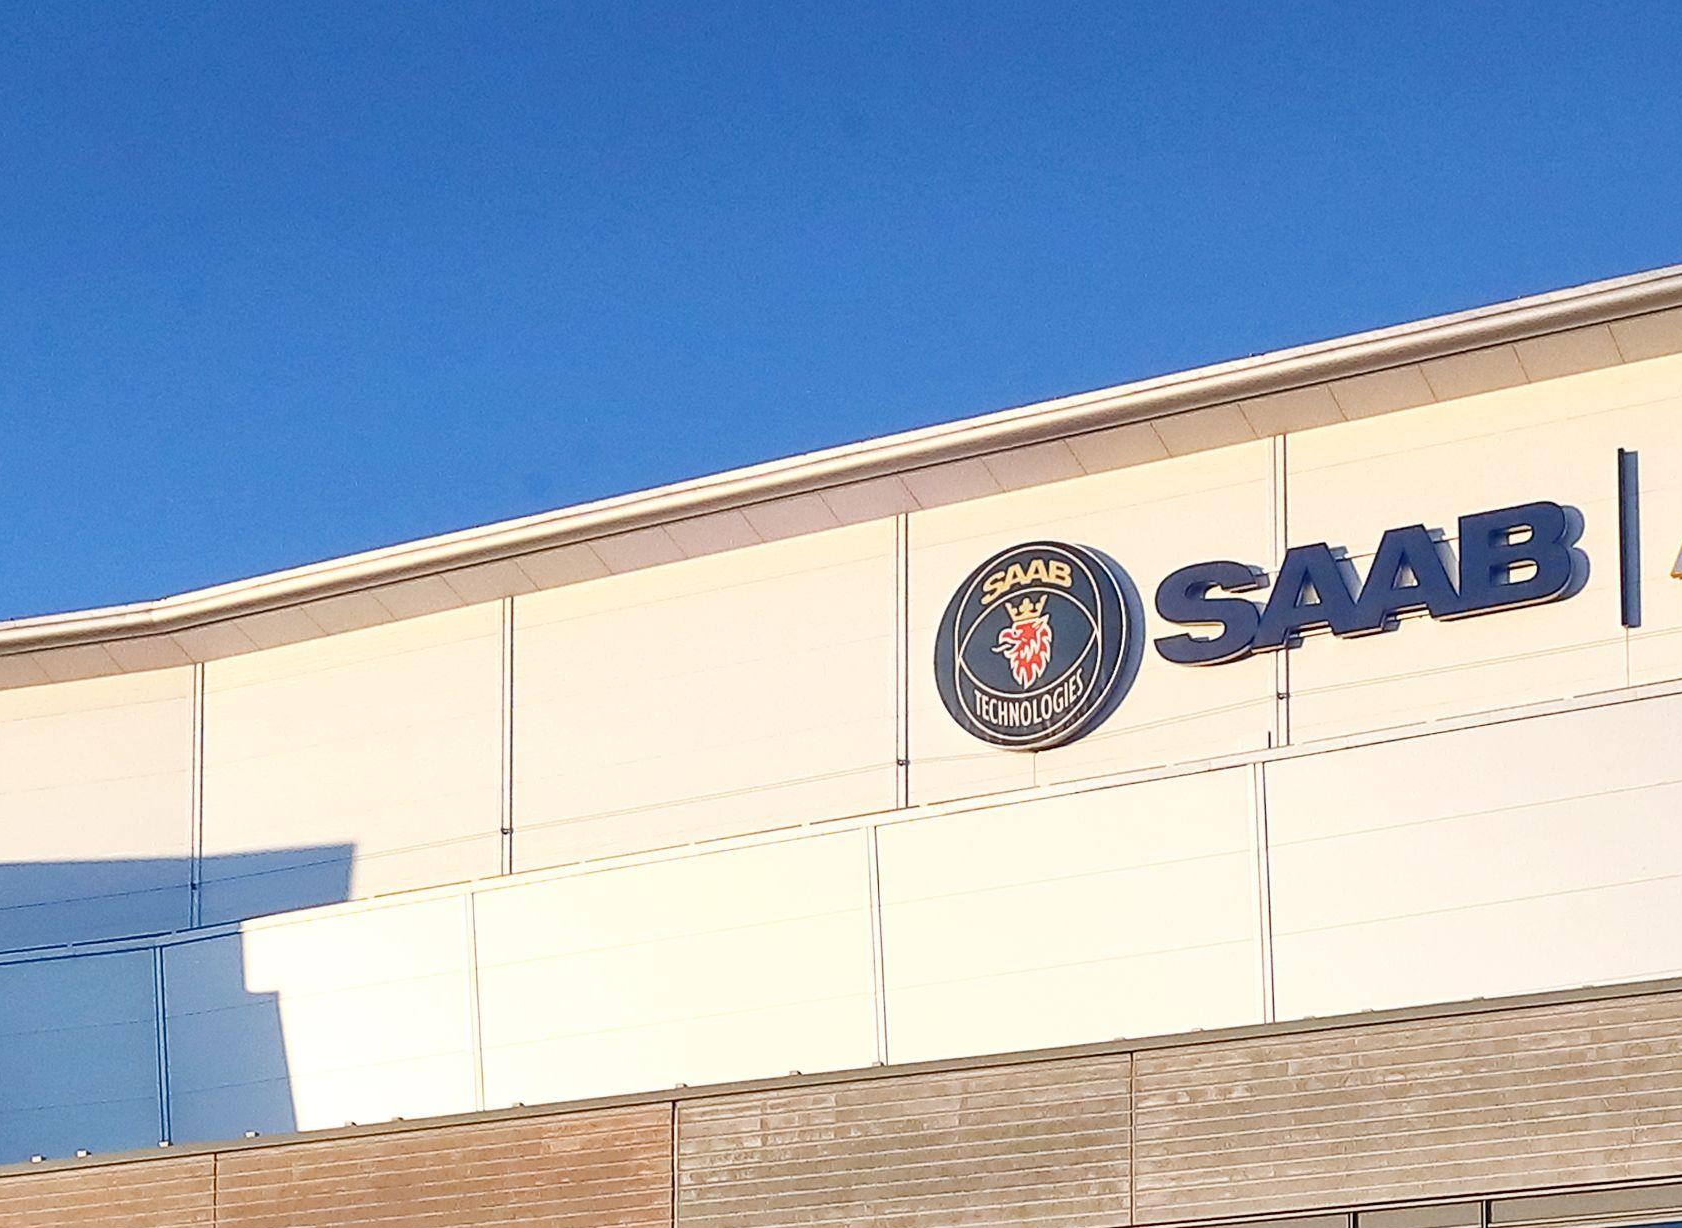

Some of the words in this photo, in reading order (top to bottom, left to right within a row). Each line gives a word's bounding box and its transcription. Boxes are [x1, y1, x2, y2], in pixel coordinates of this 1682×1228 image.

[980, 558, 1073, 606] SAAB
[1153, 500, 1579, 667] SAAB
[973, 667, 1084, 728] TECHNOLOGIES
